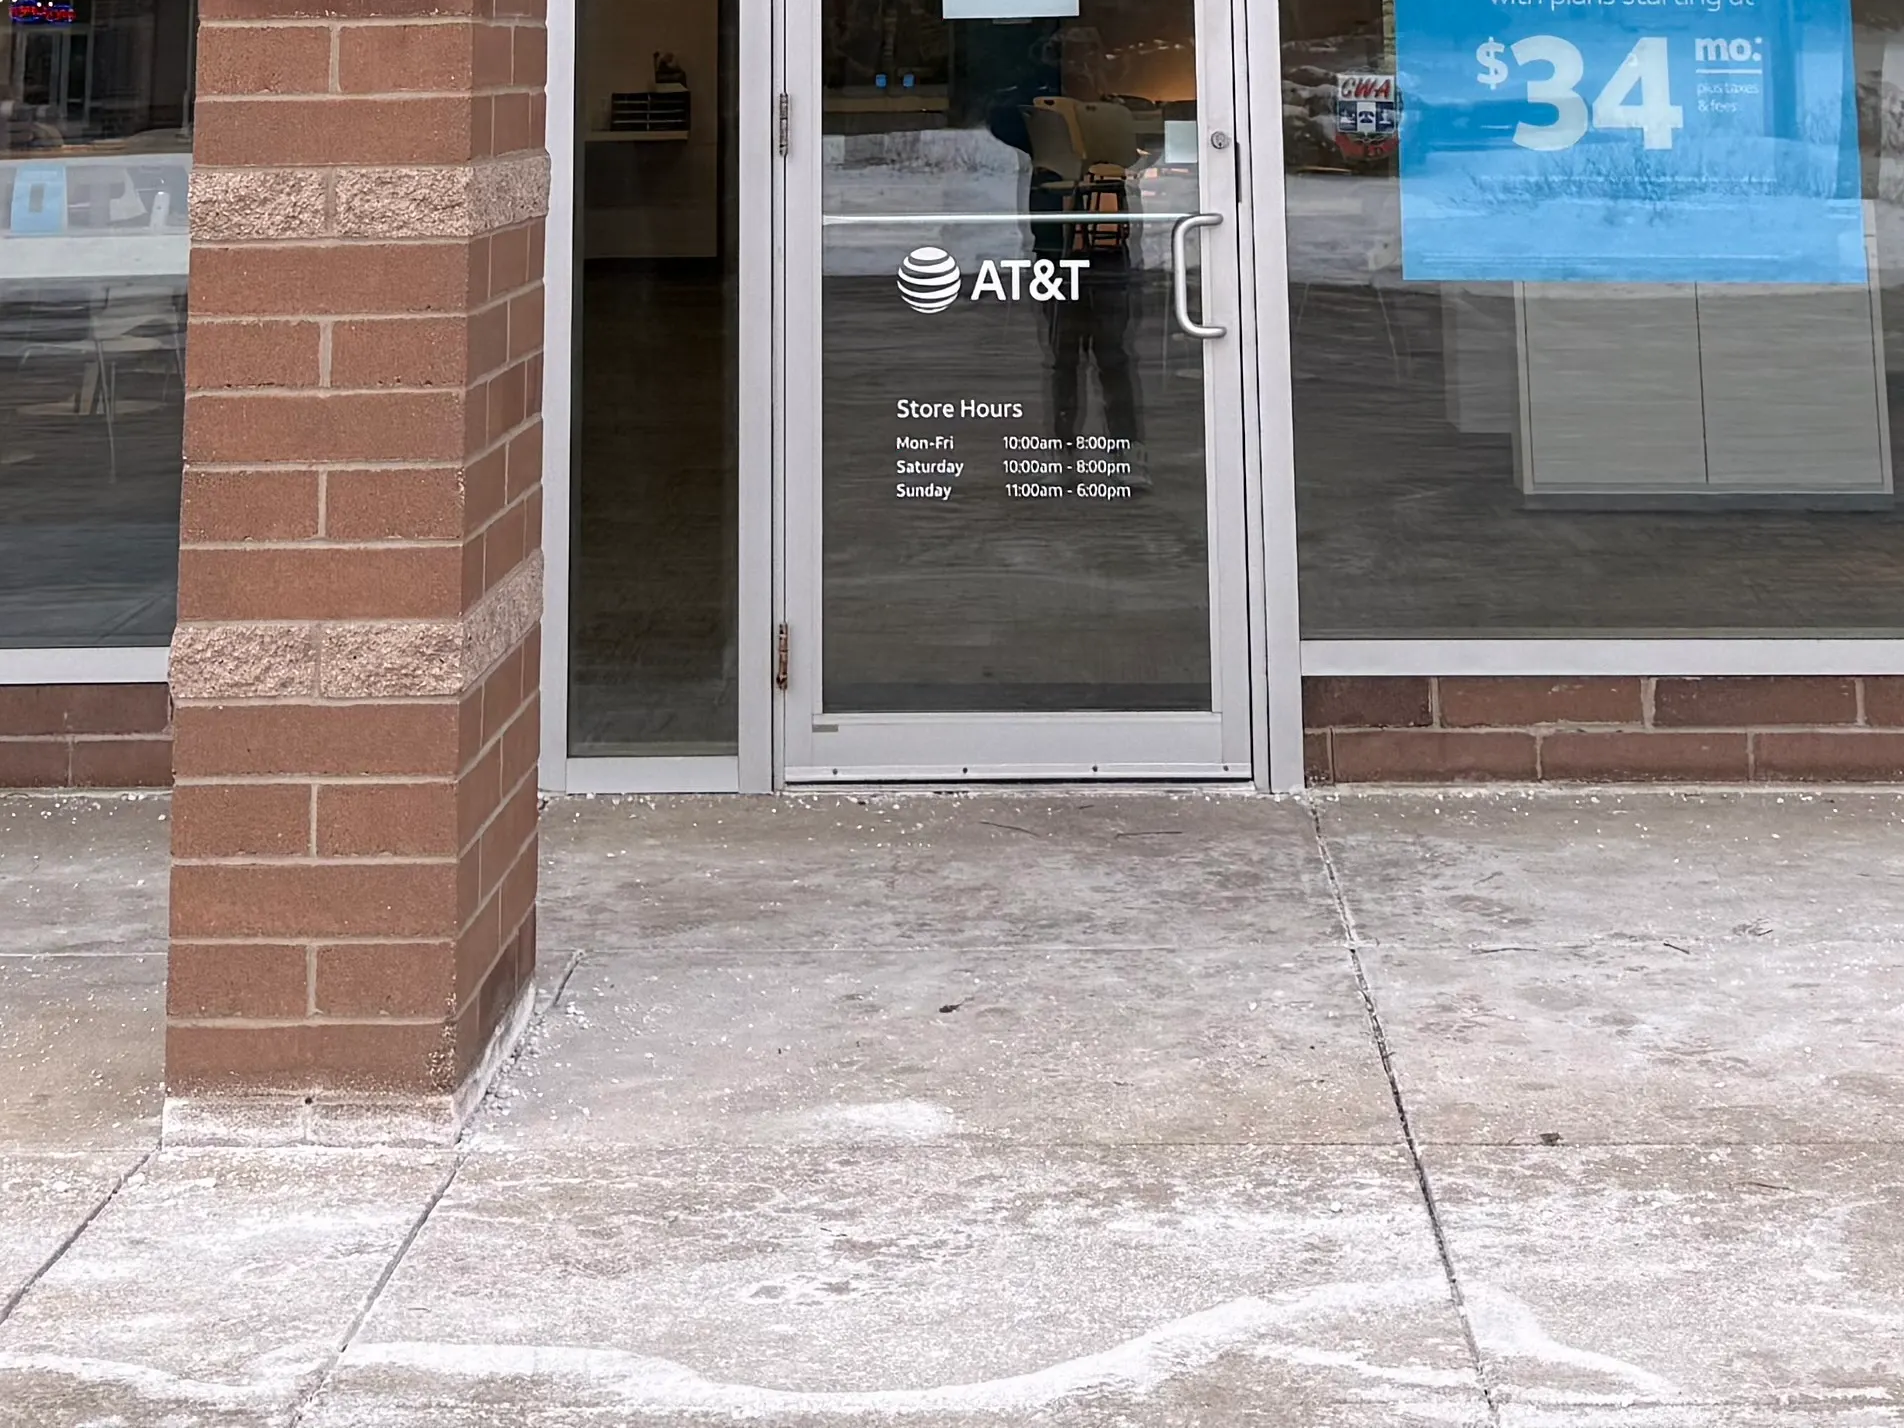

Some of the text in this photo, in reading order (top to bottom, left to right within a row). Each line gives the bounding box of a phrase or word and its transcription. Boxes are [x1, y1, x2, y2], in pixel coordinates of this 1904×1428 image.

[1340, 76, 1392, 100] CWA
[970, 259, 1090, 301] AT&T
[896, 399, 1024, 419] Store Hours
[895, 435, 955, 451] Mon-Fri
[1002, 435, 1063, 451] 10:00am
[1075, 435, 1131, 453] 8:00pm
[895, 459, 965, 477] Saturday
[1002, 459, 1063, 474] 10:00am
[1076, 459, 1132, 477] 8:00pm
[895, 482, 952, 501] Sunday
[1005, 483, 1063, 498] 11:00am
[1076, 483, 1132, 501] 6:00pm
